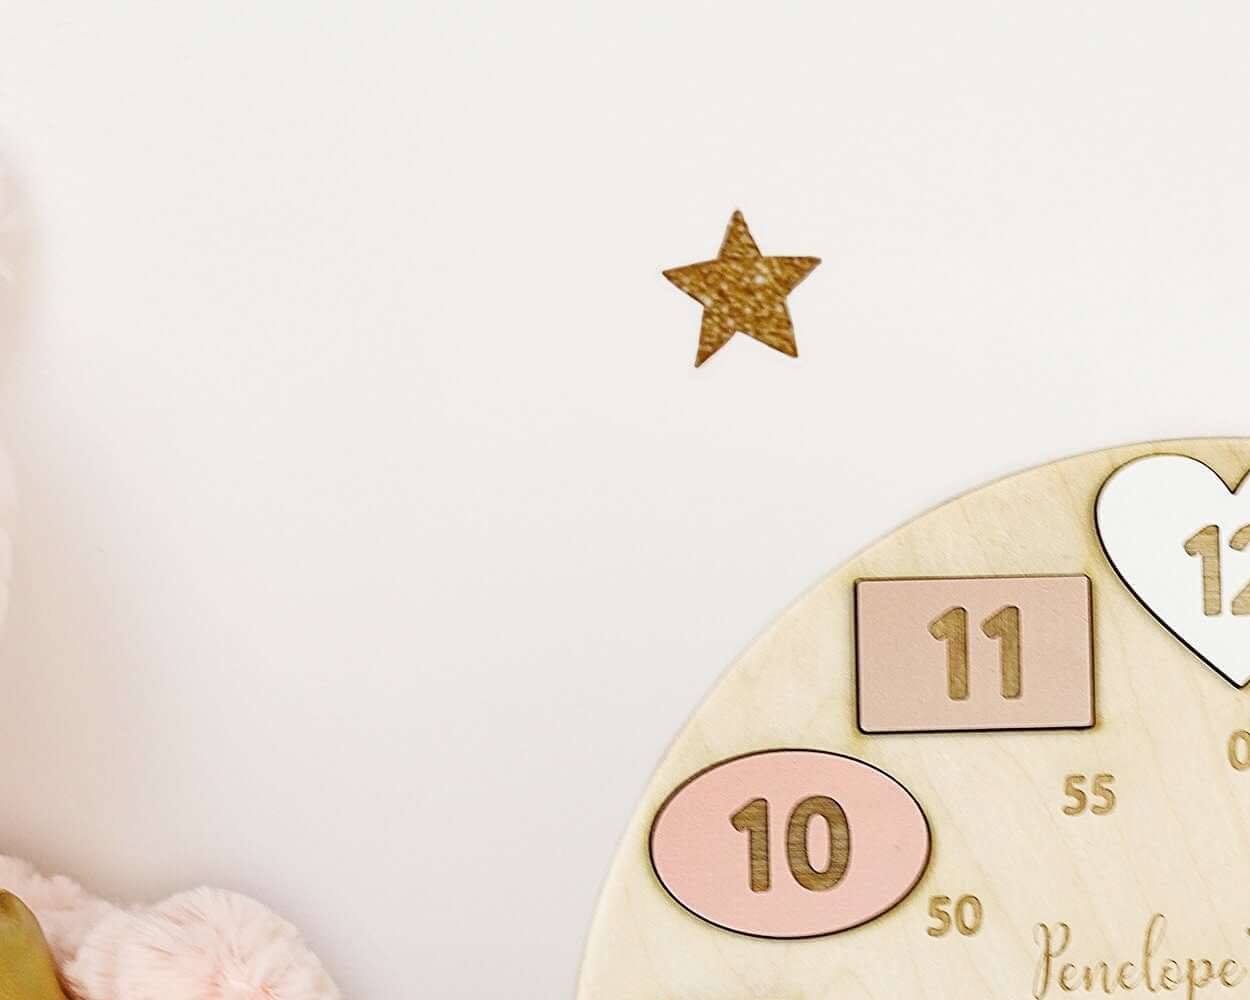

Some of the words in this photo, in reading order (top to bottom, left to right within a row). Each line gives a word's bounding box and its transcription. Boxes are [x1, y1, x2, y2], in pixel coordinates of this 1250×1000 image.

[929, 605, 1022, 701] 11
[1062, 772, 1116, 816] 55
[729, 795, 852, 893] 10
[926, 894, 983, 937] 50
